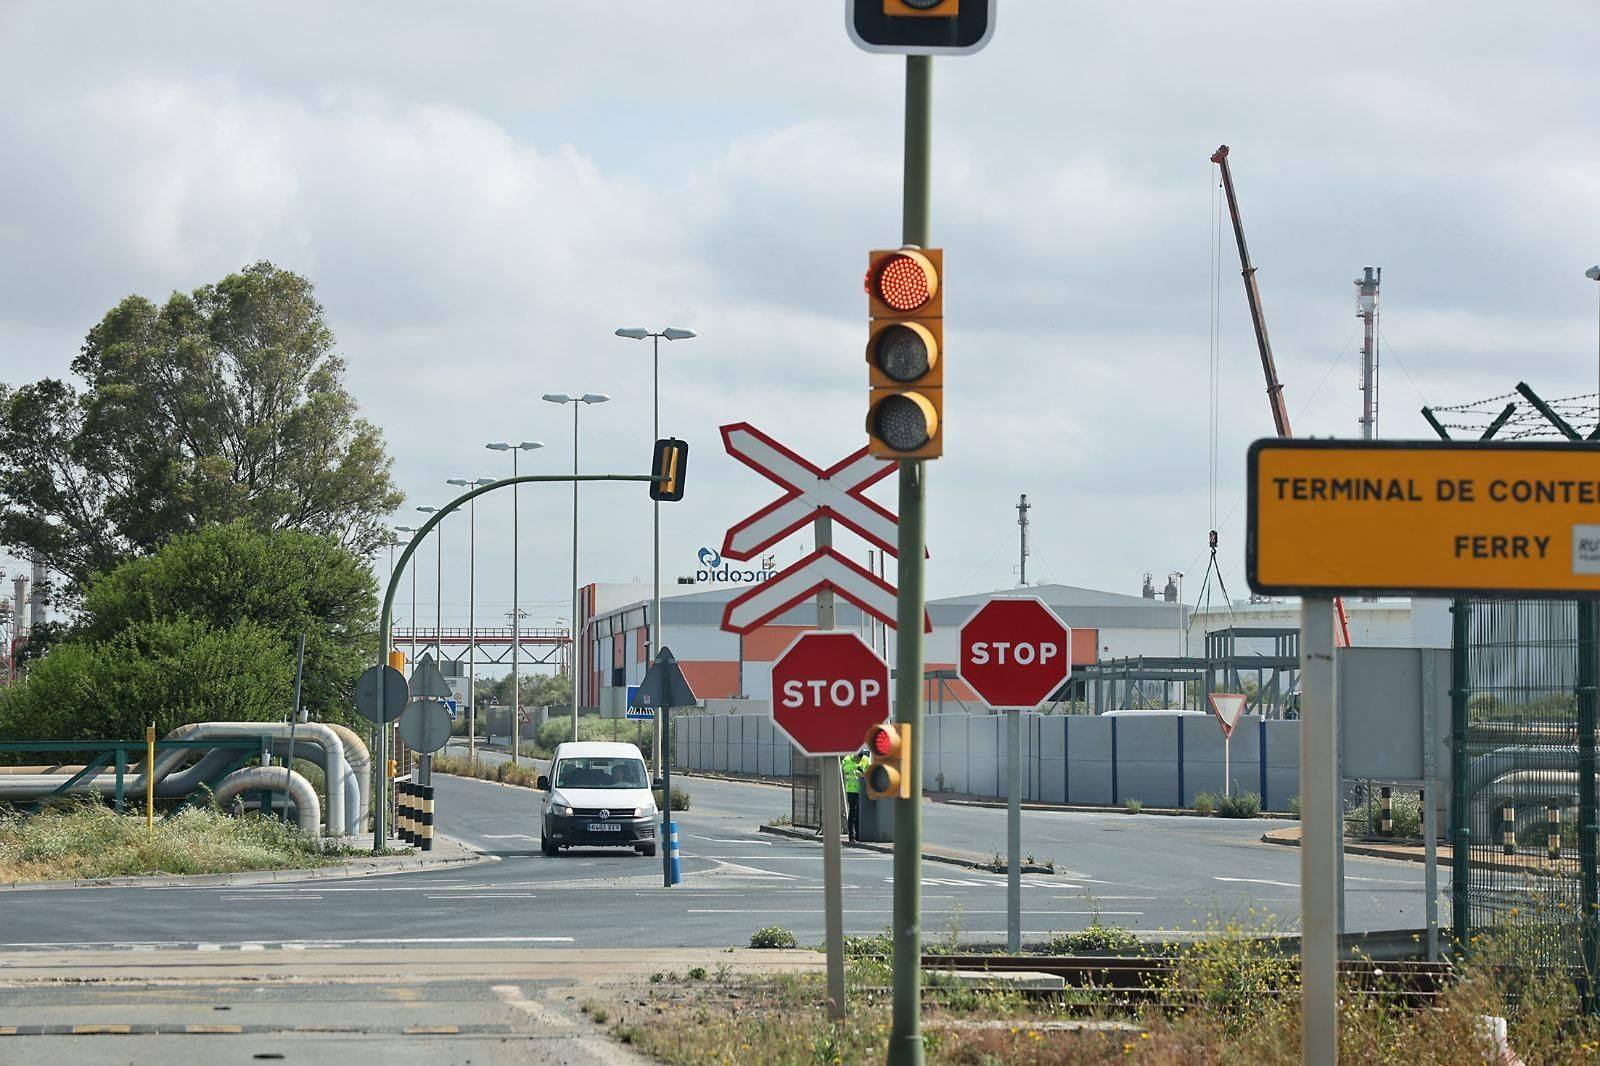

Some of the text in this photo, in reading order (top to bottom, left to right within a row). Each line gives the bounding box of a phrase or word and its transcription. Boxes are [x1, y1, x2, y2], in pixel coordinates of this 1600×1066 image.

[1273, 478, 1600, 504] TERMINAL DE CONTE
[1454, 536, 1551, 559] FERRY
[971, 642, 1058, 665] STOP
[782, 679, 881, 708] STOP
